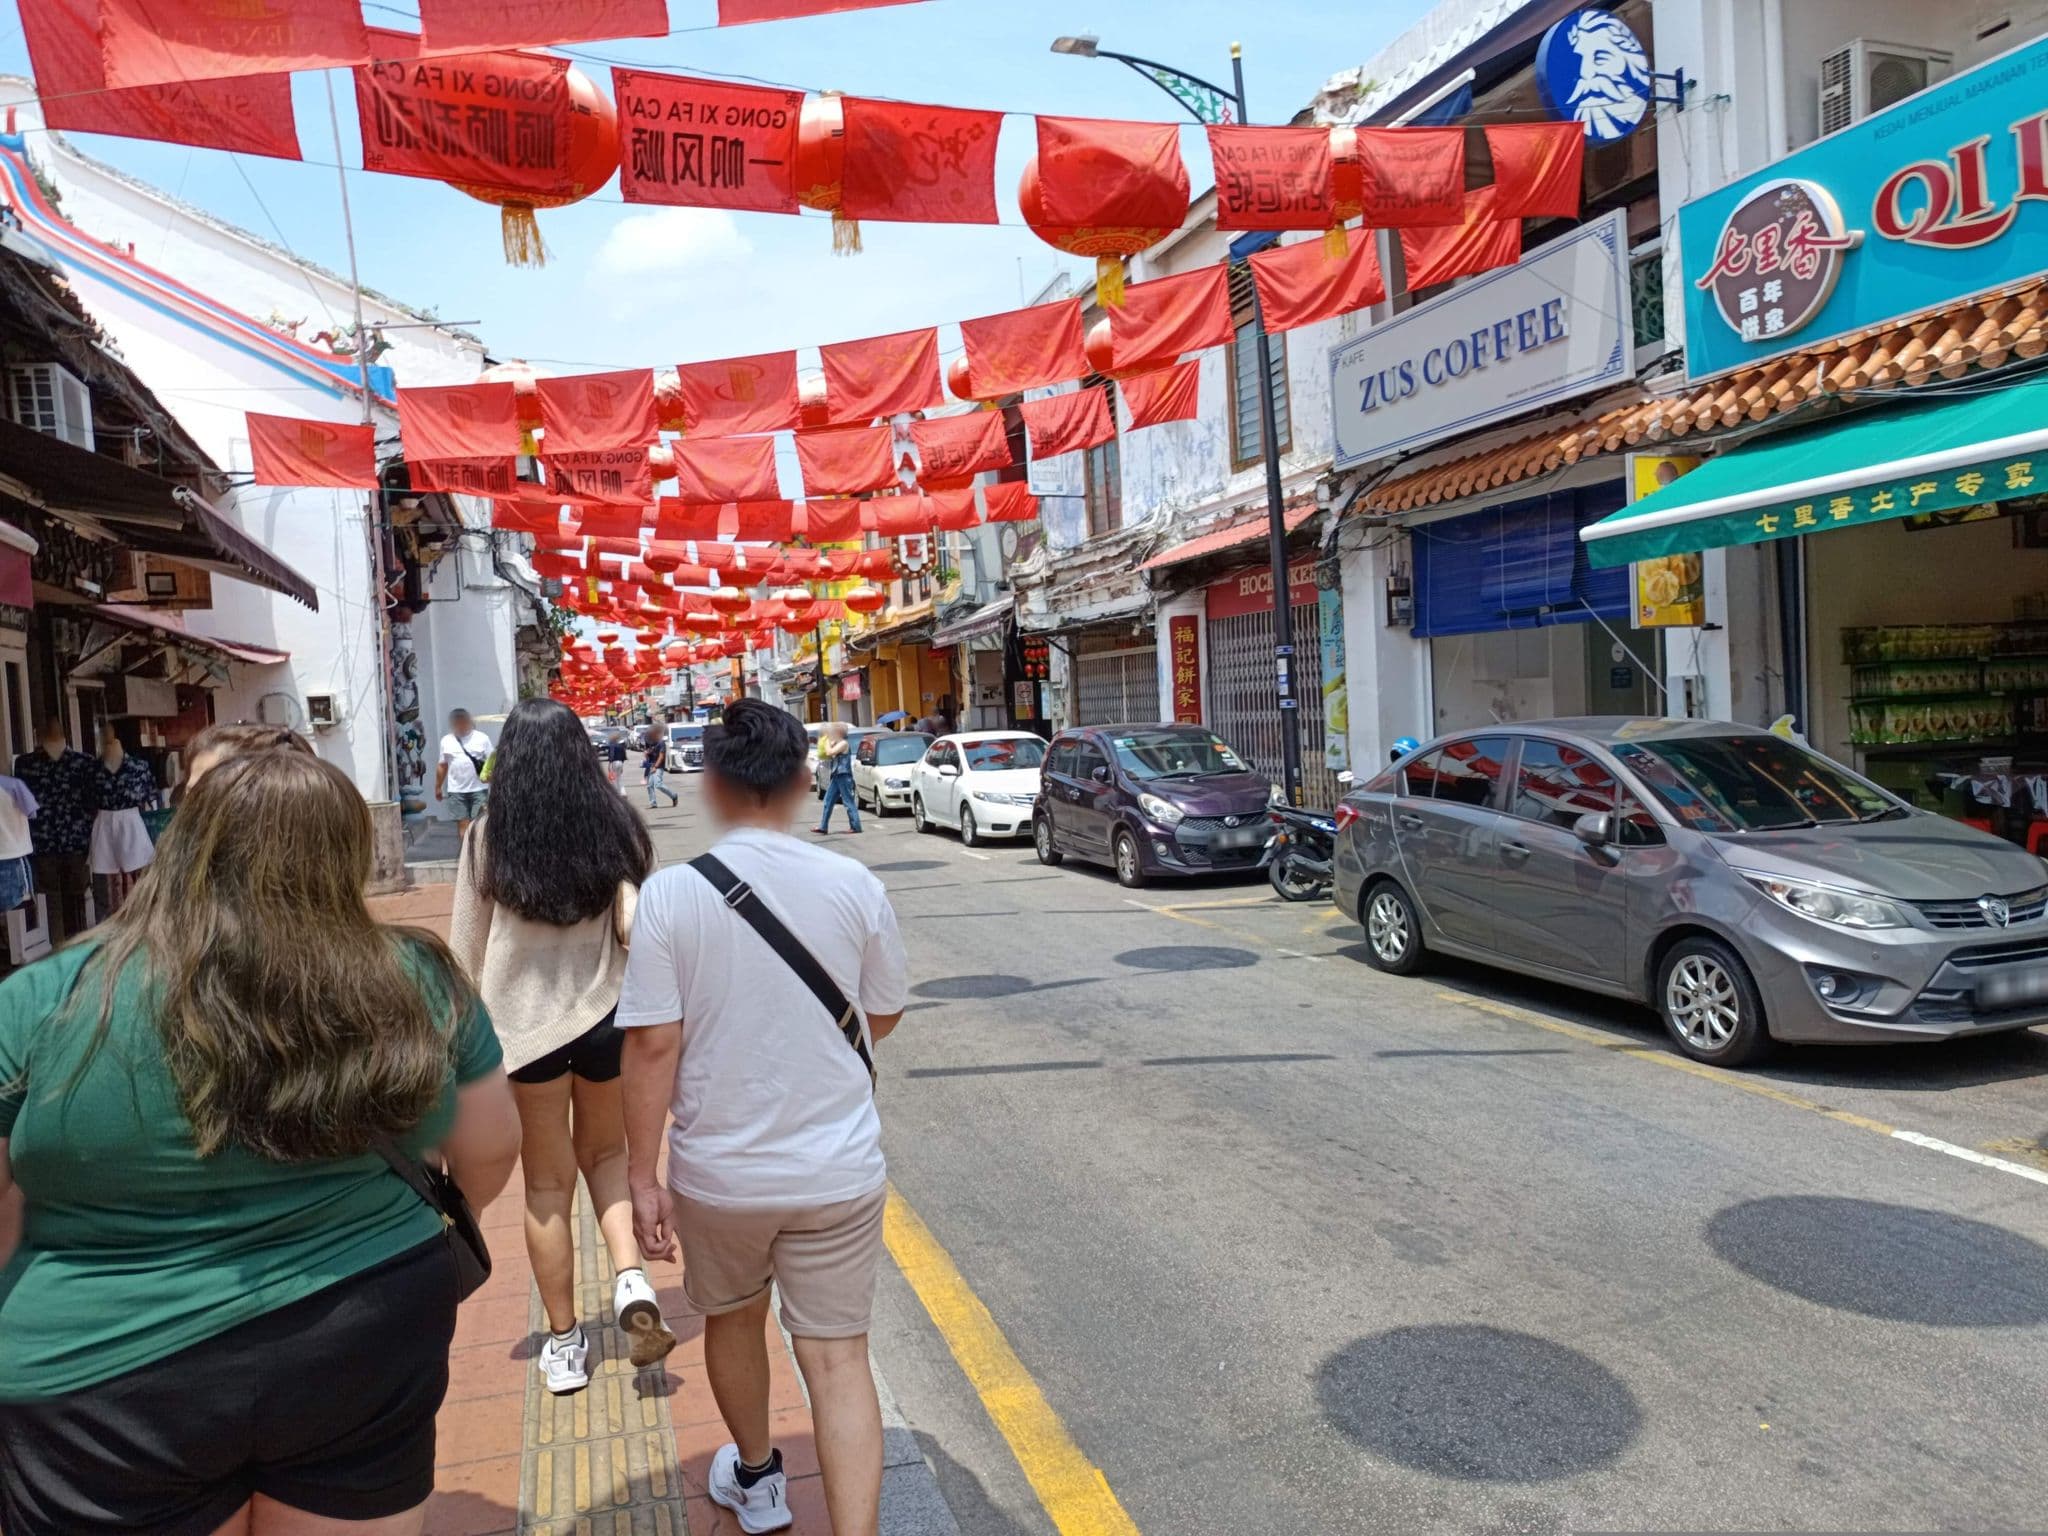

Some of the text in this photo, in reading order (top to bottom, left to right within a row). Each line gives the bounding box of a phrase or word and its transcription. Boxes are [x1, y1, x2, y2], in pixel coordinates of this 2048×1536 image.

[1965, 62, 2028, 99] MAKANAN
[1872, 133, 2018, 250] QI
[1695, 210, 1857, 290] 七里香
[1739, 278, 1784, 315] 百年
[1342, 348, 1366, 370] KAFE
[1358, 359, 1417, 414] ZUS
[1422, 297, 1568, 386] COFFEE
[1755, 461, 2035, 534] 七里香土产专卖
[1174, 626, 1197, 708] 福記餅家
